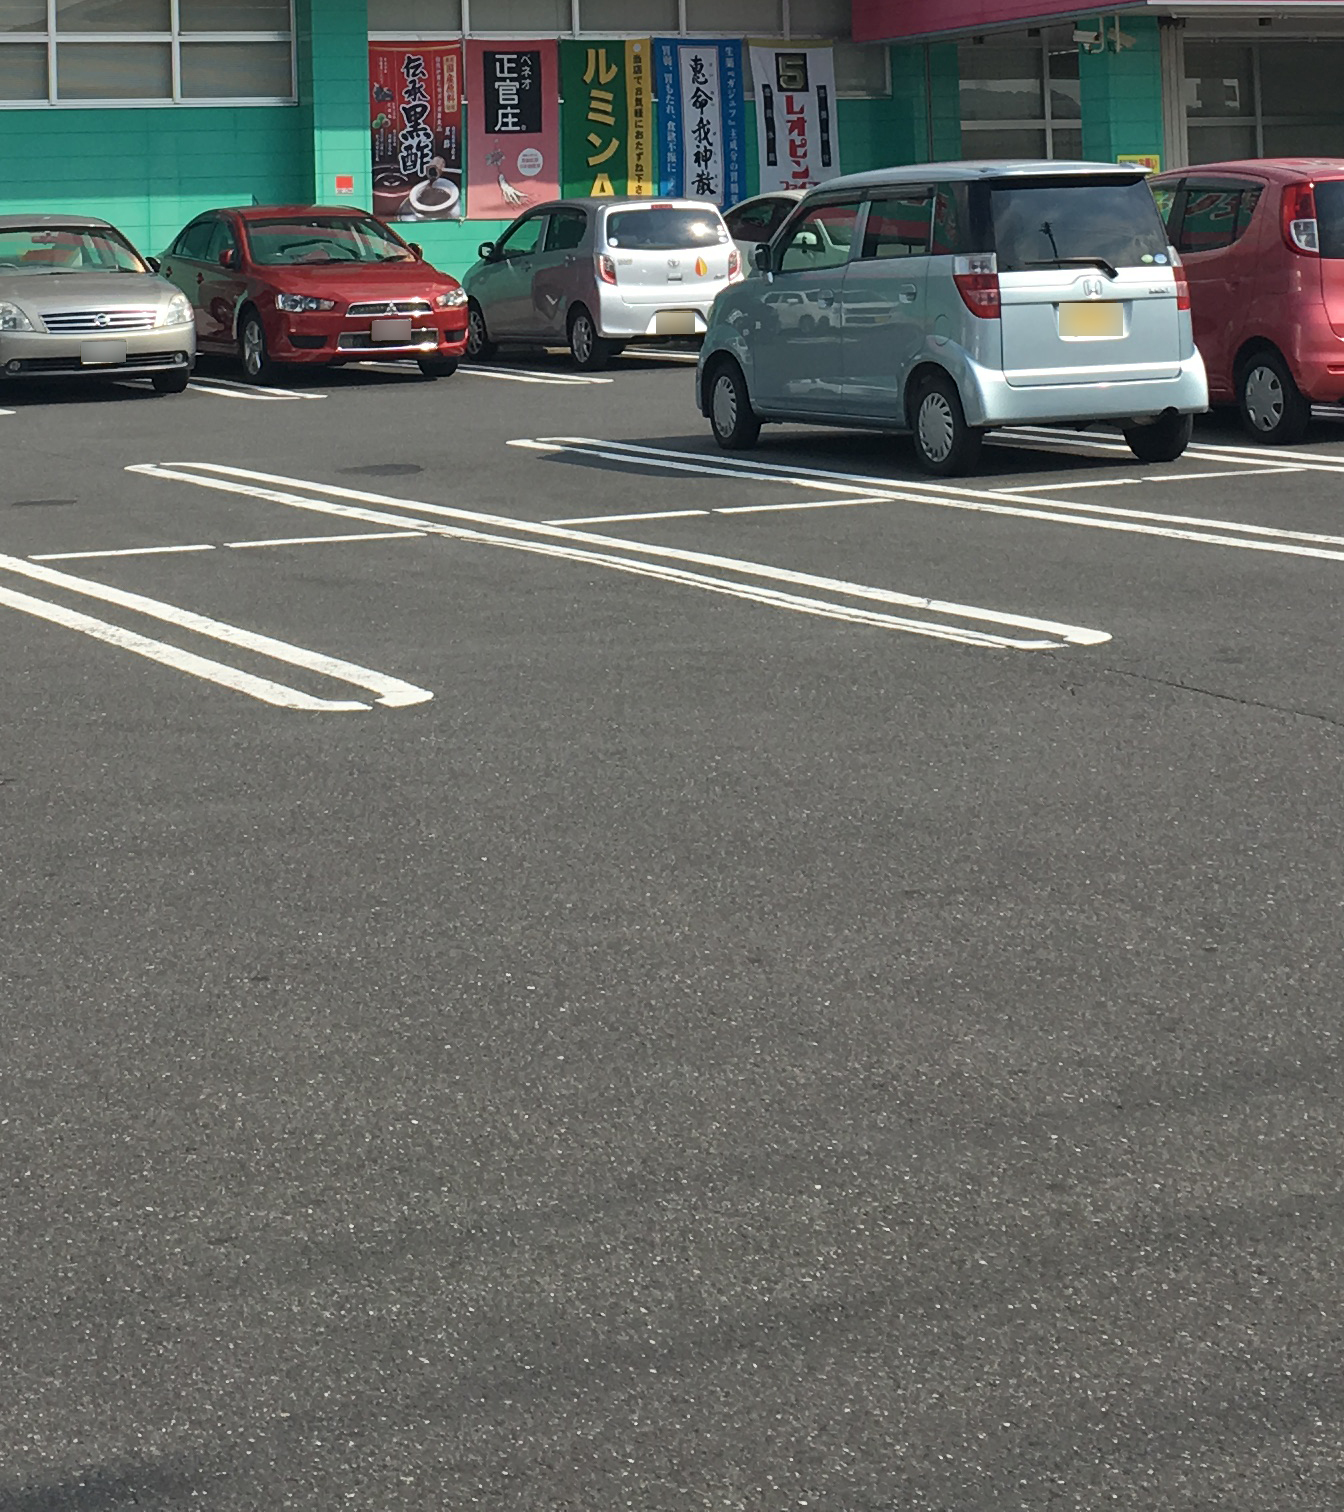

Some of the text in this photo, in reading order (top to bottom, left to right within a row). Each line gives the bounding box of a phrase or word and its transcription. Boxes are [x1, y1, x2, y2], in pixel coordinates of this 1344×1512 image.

[399, 54, 433, 177] 伝承黒酢
[494, 54, 521, 131] 正官庄
[785, 94, 810, 179] レオピン
